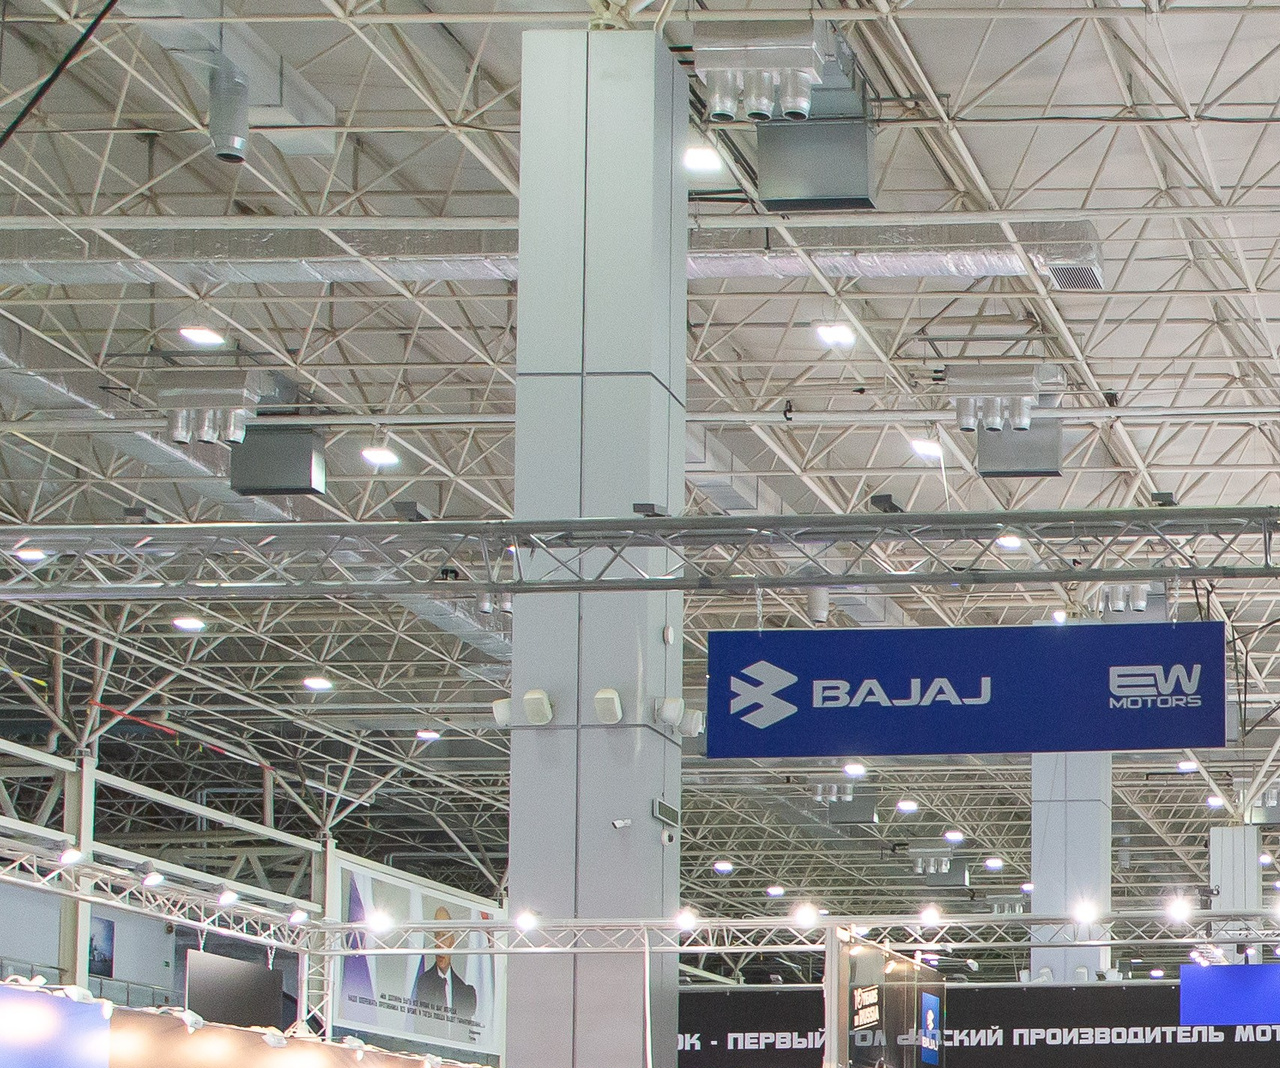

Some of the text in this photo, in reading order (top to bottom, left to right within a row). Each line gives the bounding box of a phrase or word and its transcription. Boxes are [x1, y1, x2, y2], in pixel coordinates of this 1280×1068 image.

[813, 676, 992, 708] BAJAJ
[1109, 695, 1202, 709] MOTORS
[727, 1028, 826, 1050] ПЕРВЫЙ
[1013, 1025, 1225, 1046] ПРОИЗВОДИТЕЛЬ
